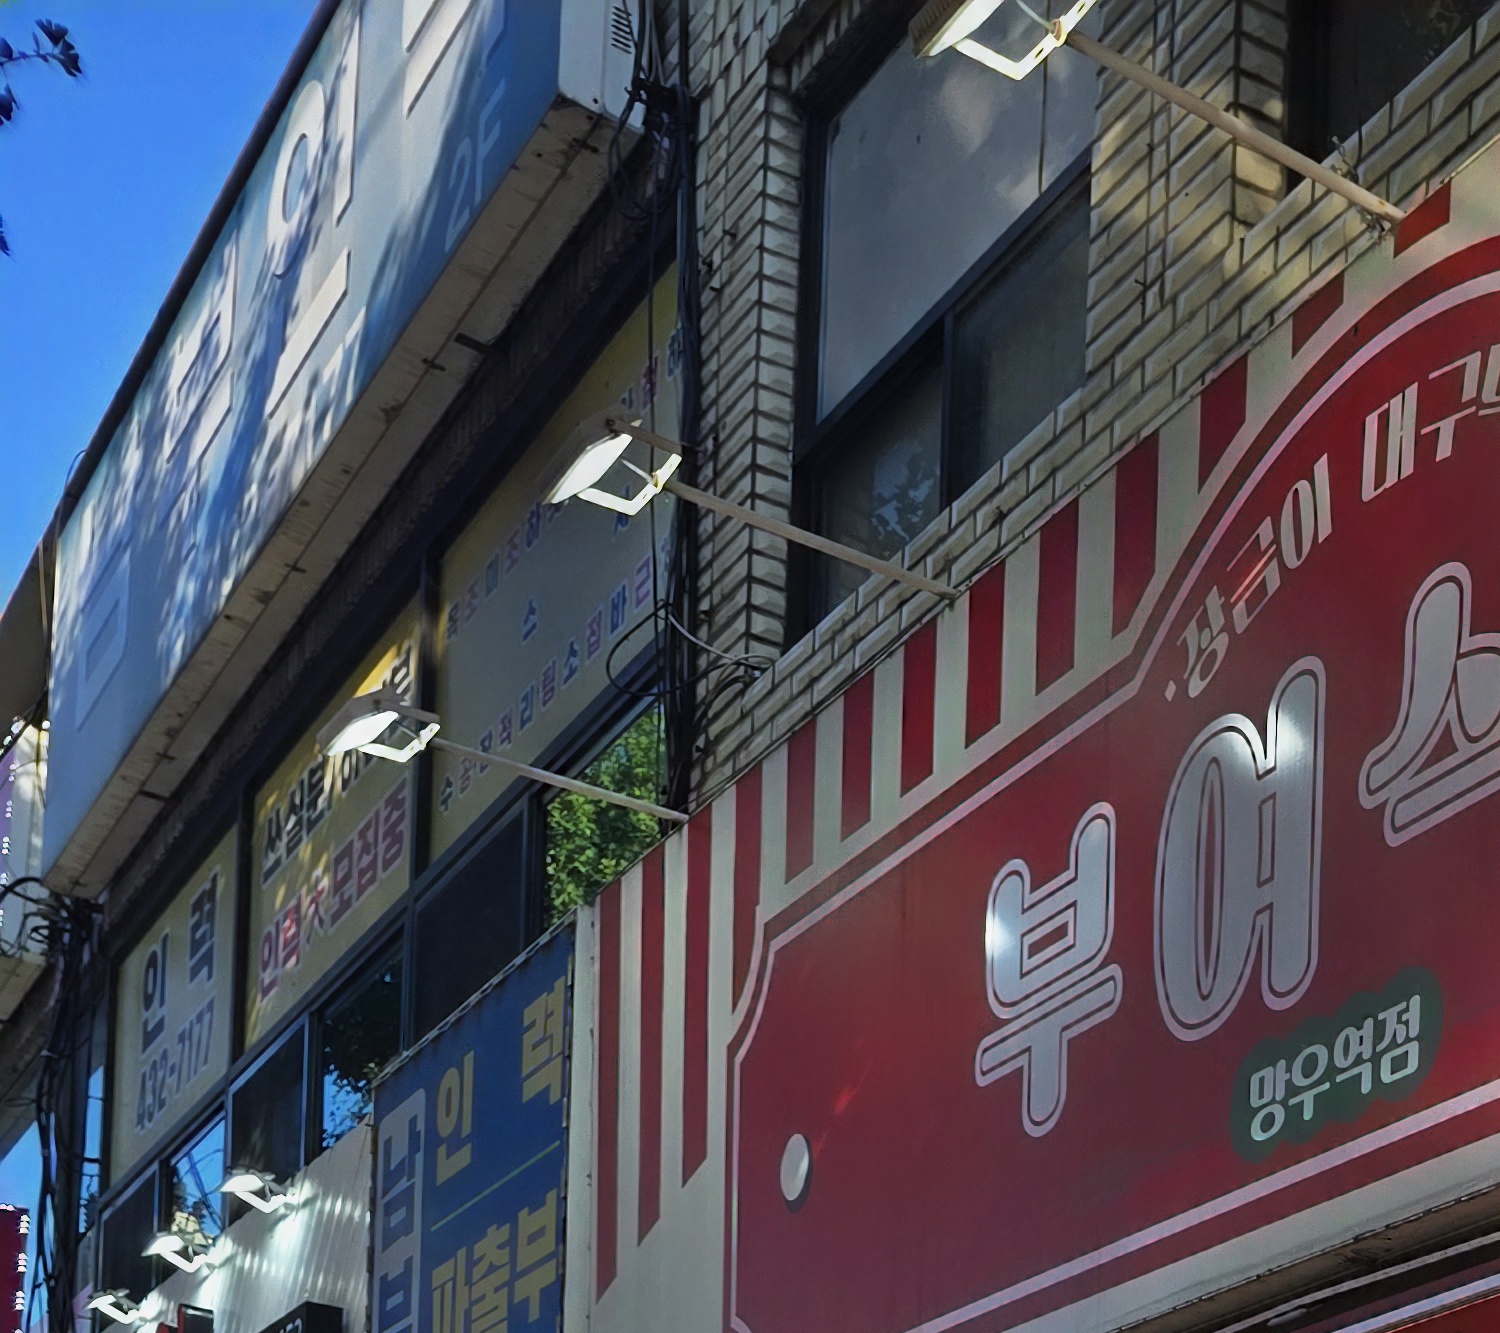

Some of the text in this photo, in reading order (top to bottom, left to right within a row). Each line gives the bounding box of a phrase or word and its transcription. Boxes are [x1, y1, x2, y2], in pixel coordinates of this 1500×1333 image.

[1177, 452, 1332, 699] 장금이
[143, 870, 220, 1057] 인력
[135, 1003, 215, 1134] 432-7177
[435, 974, 566, 1188] 인력
[1248, 992, 1422, 1143] 망우역점
